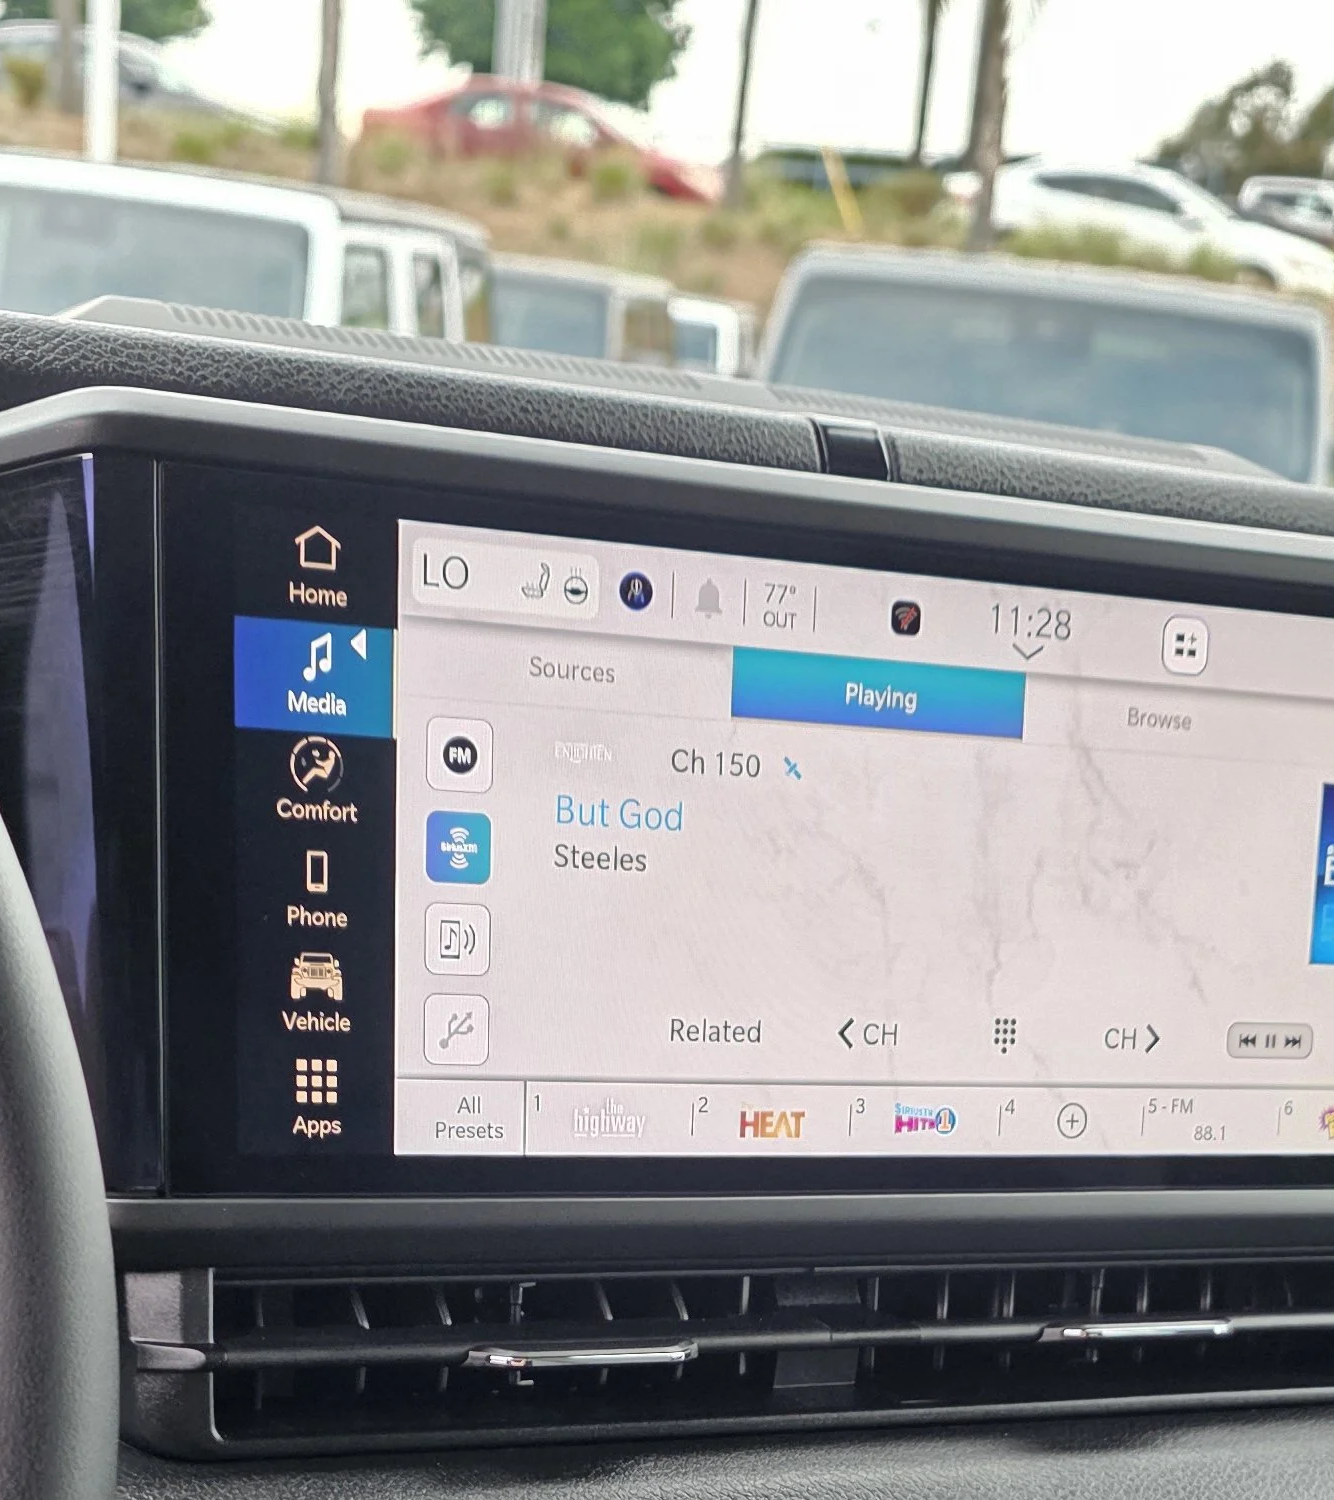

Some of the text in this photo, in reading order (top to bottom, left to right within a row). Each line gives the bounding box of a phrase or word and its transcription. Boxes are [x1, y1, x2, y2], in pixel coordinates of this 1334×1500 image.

[422, 552, 469, 591] LO
[288, 582, 348, 609] Home
[763, 582, 797, 606] 77°
[761, 609, 797, 631] OUT
[991, 604, 1072, 642] 11:28
[528, 655, 616, 684] Sources
[287, 690, 347, 717] Media
[845, 683, 918, 713] Playing
[1127, 706, 1192, 732] Browse
[448, 746, 471, 765] FM
[671, 748, 761, 778] Ch 150
[276, 798, 358, 825] Comfort
[556, 794, 683, 832] But God
[554, 843, 647, 872] Steeles
[286, 906, 348, 930] Phone
[281, 1011, 351, 1034] Vehicle
[669, 1017, 762, 1045] Related
[864, 1024, 898, 1046] CH
[1104, 1027, 1138, 1050] CH
[457, 1096, 481, 1115] All
[533, 1094, 541, 1112] 1
[698, 1096, 709, 1114] 2
[855, 1098, 865, 1114] 3
[1004, 1100, 1015, 1114] 4
[1148, 1098, 1158, 1114] 5
[1171, 1098, 1194, 1114] FM
[1284, 1100, 1293, 1115] 6
[292, 1115, 342, 1138] Apps
[434, 1121, 504, 1141] Presets
[739, 1110, 805, 1138] HEAT
[1193, 1125, 1226, 1141] 88.1
